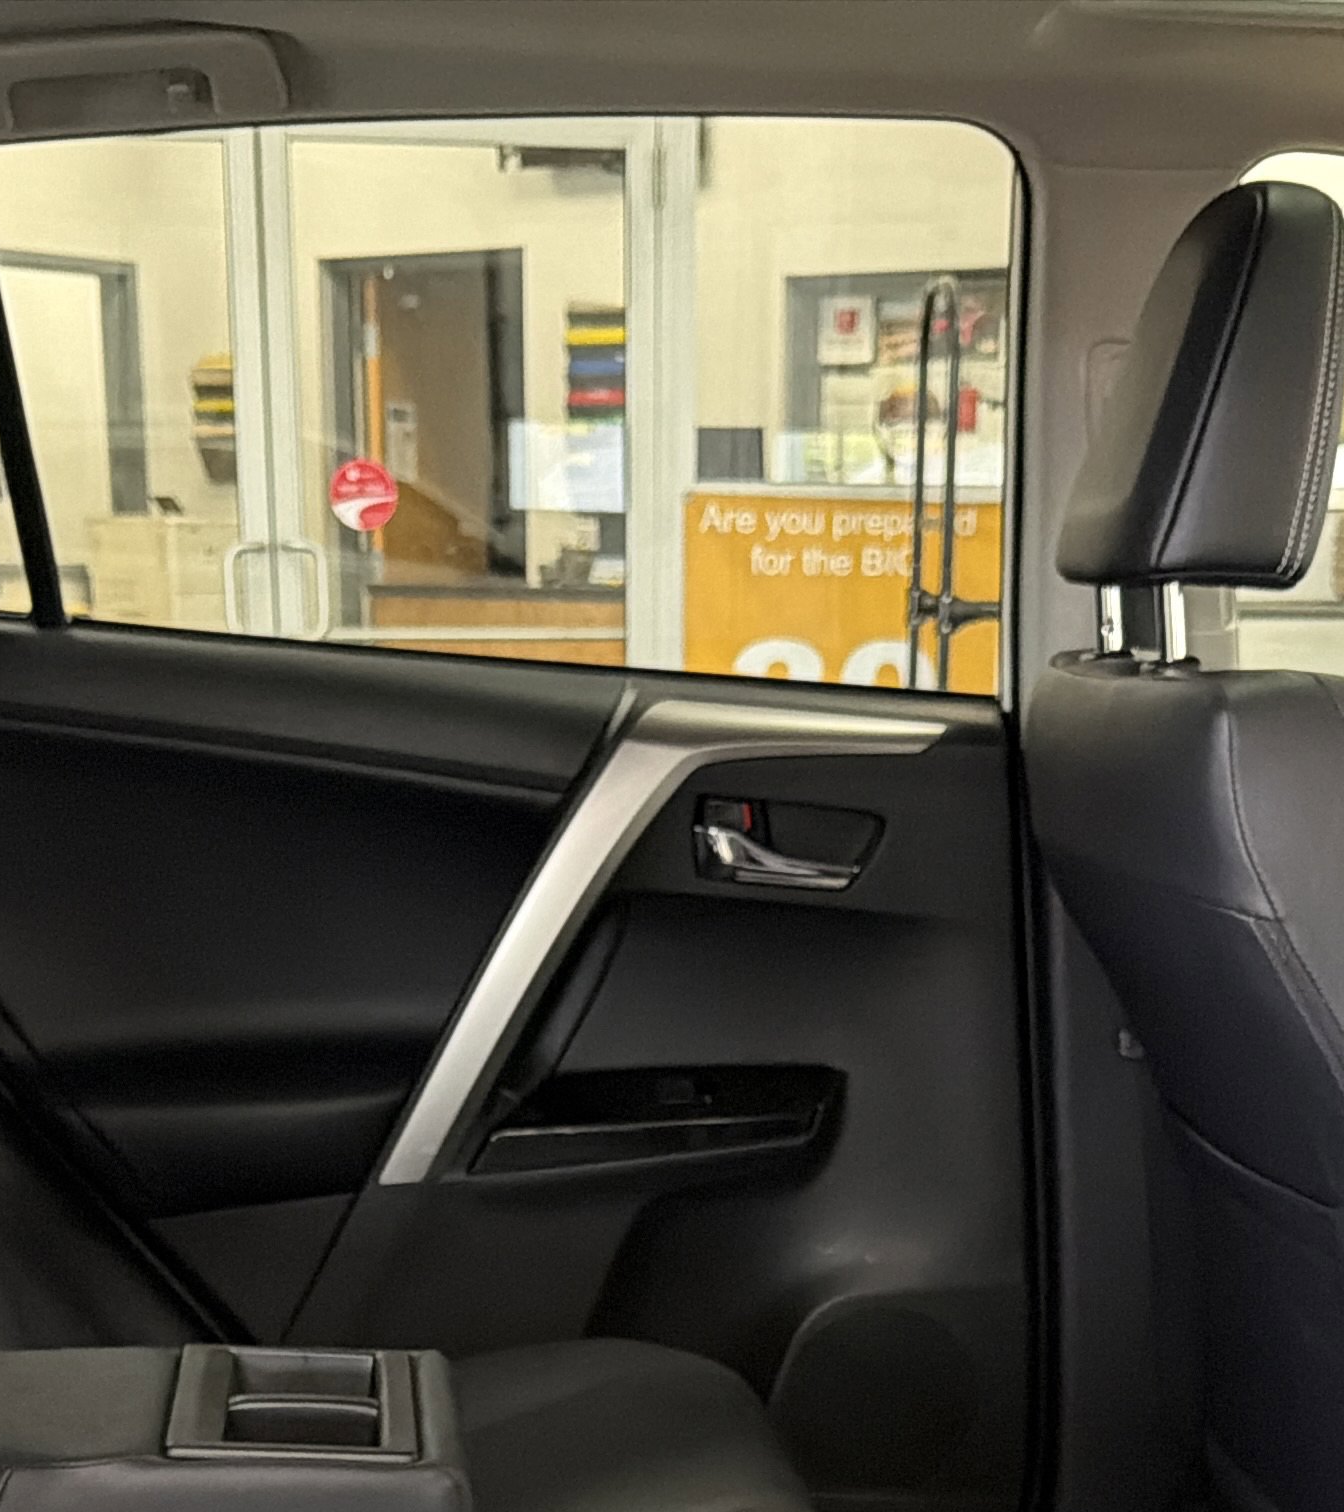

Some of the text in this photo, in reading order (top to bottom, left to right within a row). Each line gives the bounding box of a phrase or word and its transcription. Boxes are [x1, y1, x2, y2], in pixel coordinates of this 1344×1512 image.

[699, 504, 756, 534] Are
[765, 509, 825, 541] you
[751, 544, 794, 576] for
[802, 546, 854, 576] the
